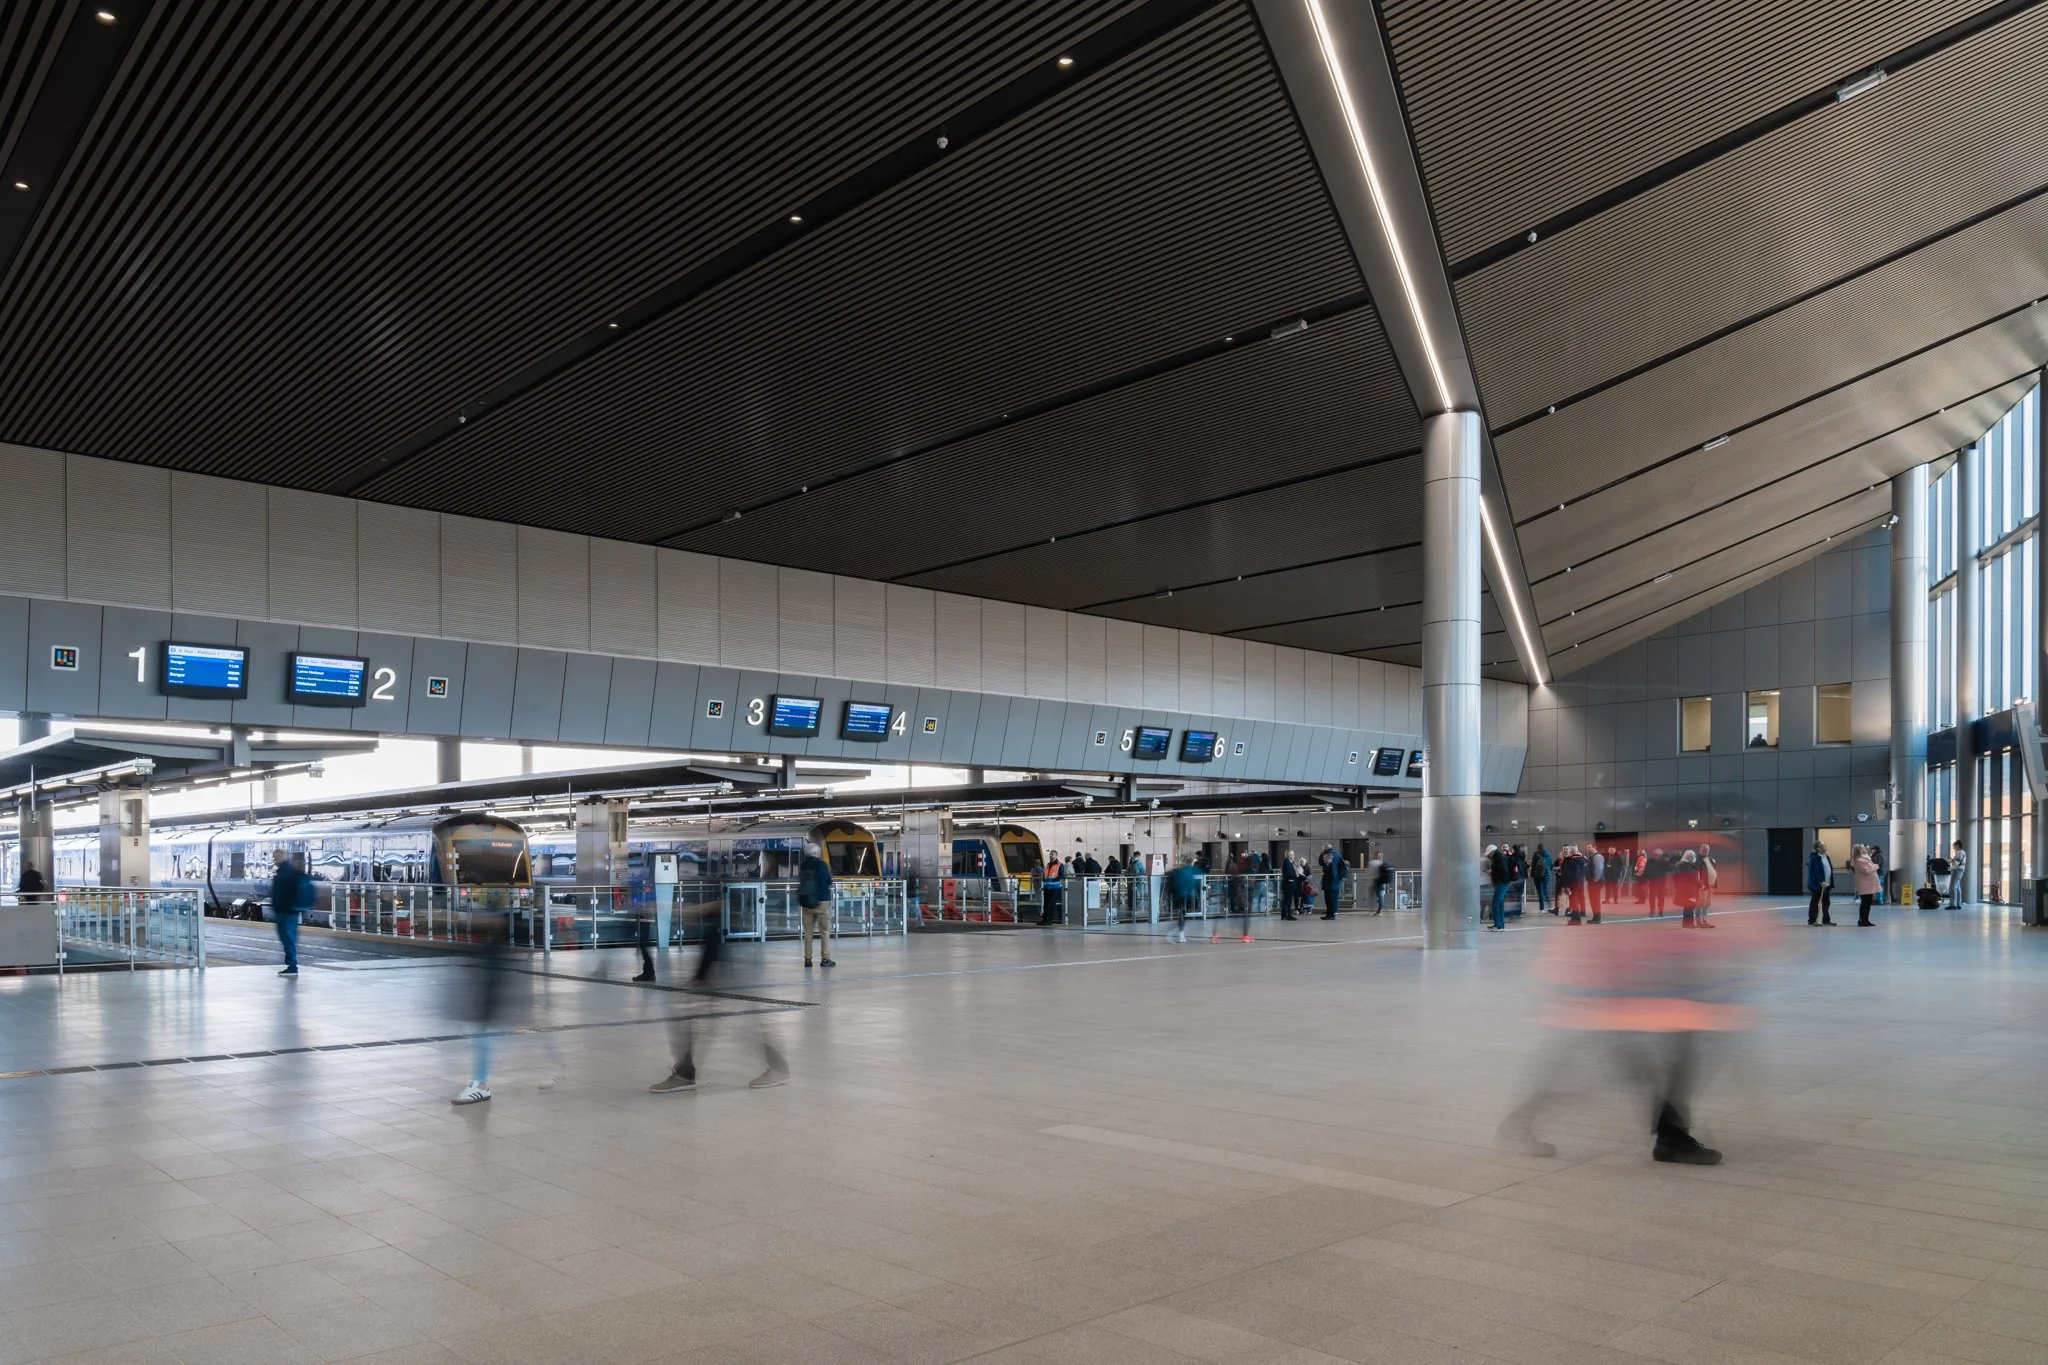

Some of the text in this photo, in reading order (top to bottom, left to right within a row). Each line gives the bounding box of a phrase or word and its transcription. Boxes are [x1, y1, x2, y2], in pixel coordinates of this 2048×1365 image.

[129, 647, 145, 682] 1
[372, 667, 396, 700] 2
[747, 698, 765, 726] 3
[891, 711, 907, 736] 4
[1120, 729, 1134, 752] 5
[1213, 737, 1226, 758] 6
[1367, 750, 1378, 769] 7
